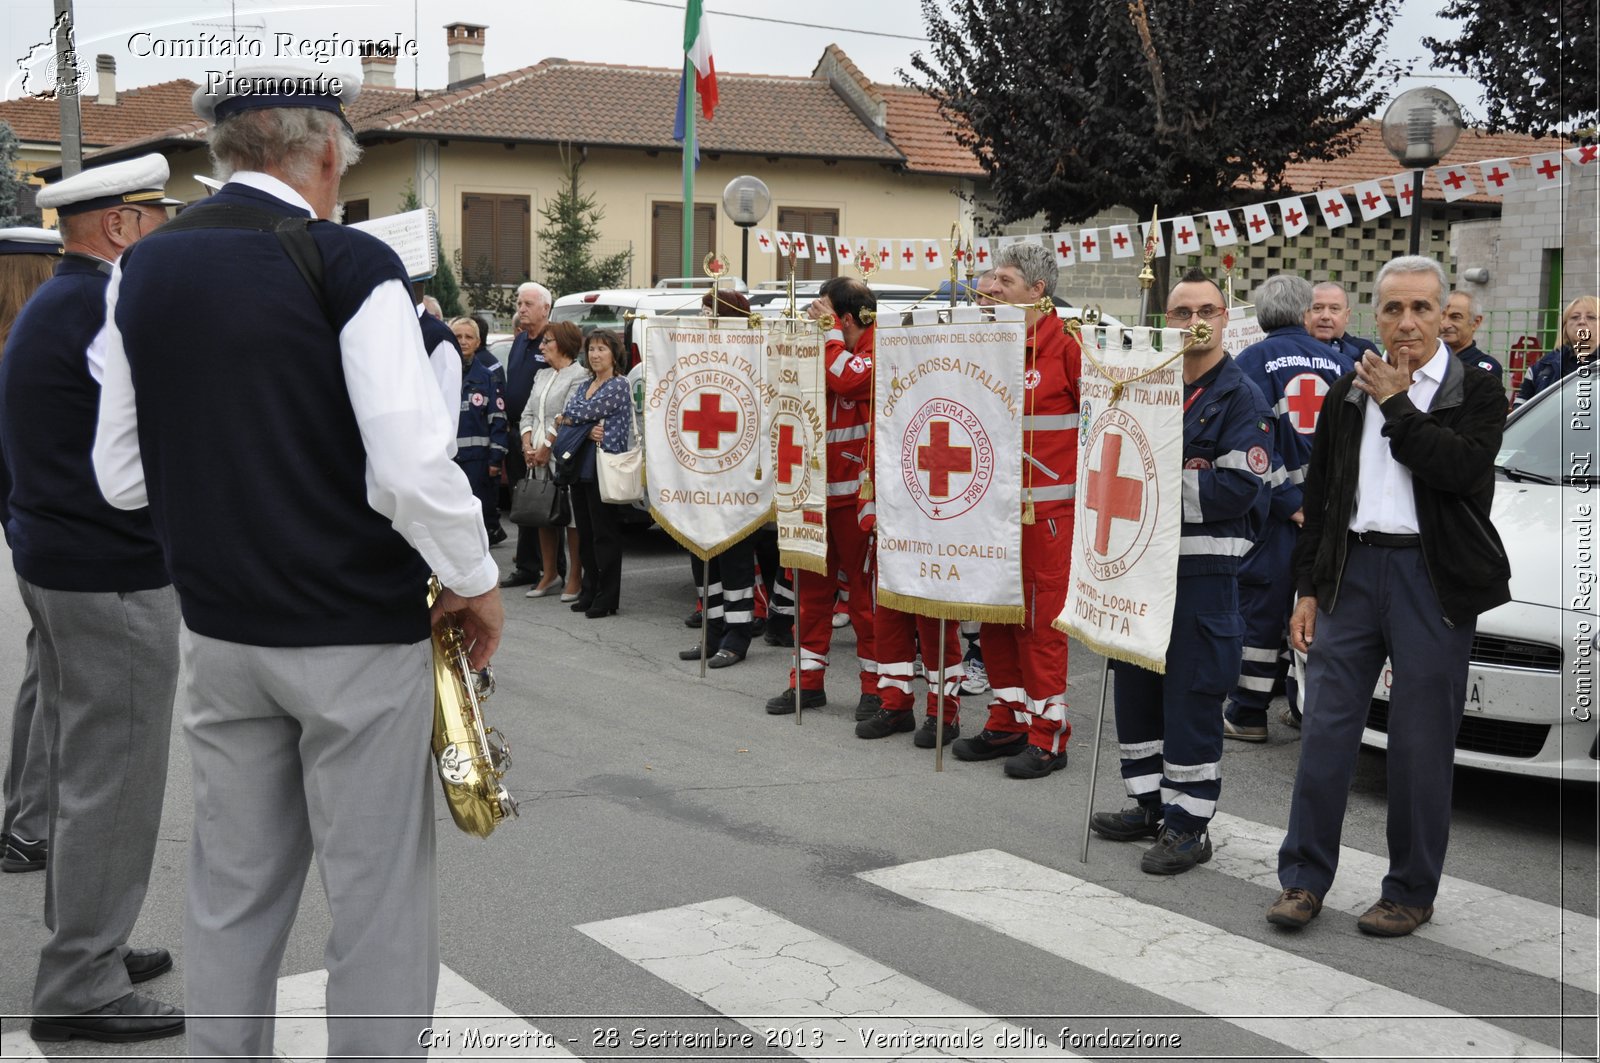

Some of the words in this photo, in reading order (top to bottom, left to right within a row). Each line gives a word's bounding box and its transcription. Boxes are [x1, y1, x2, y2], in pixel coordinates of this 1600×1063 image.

[708, 334, 722, 344] DEL
[880, 336, 909, 347] CORPO
[909, 333, 949, 346] VOLONTARI
[950, 333, 967, 344] DEL
[969, 332, 1018, 344] SOCCORSO
[678, 351, 729, 370] ROSSA
[1265, 356, 1287, 373] CROCE
[1287, 356, 1312, 368] ROSSA
[678, 380, 691, 393] DI
[694, 373, 741, 394] GINEVRA
[882, 369, 918, 418] CROCE
[918, 357, 962, 378] ROSSA
[964, 361, 1018, 420] ITALIANA
[741, 393, 754, 409] 22
[1135, 388, 1180, 406] ITALIANA
[926, 402, 963, 420] GINEVRA
[740, 411, 756, 451] AGOSTO
[963, 415, 977, 430] 22
[973, 430, 991, 481] AGOSTO
[1118, 414, 1130, 428] DI
[1131, 426, 1155, 481] GINEVRA
[717, 449, 743, 469] 1864
[904, 421, 923, 500] CONVENZIONE
[659, 488, 759, 506] SAVIGLIANO
[963, 482, 984, 504] 1864
[780, 526, 790, 539] DI
[881, 538, 932, 556] COMITATO
[938, 543, 994, 559] LOCALE
[996, 546, 1007, 560] DI
[919, 561, 961, 581] BRA
[1075, 596, 1130, 636] MORETTA
